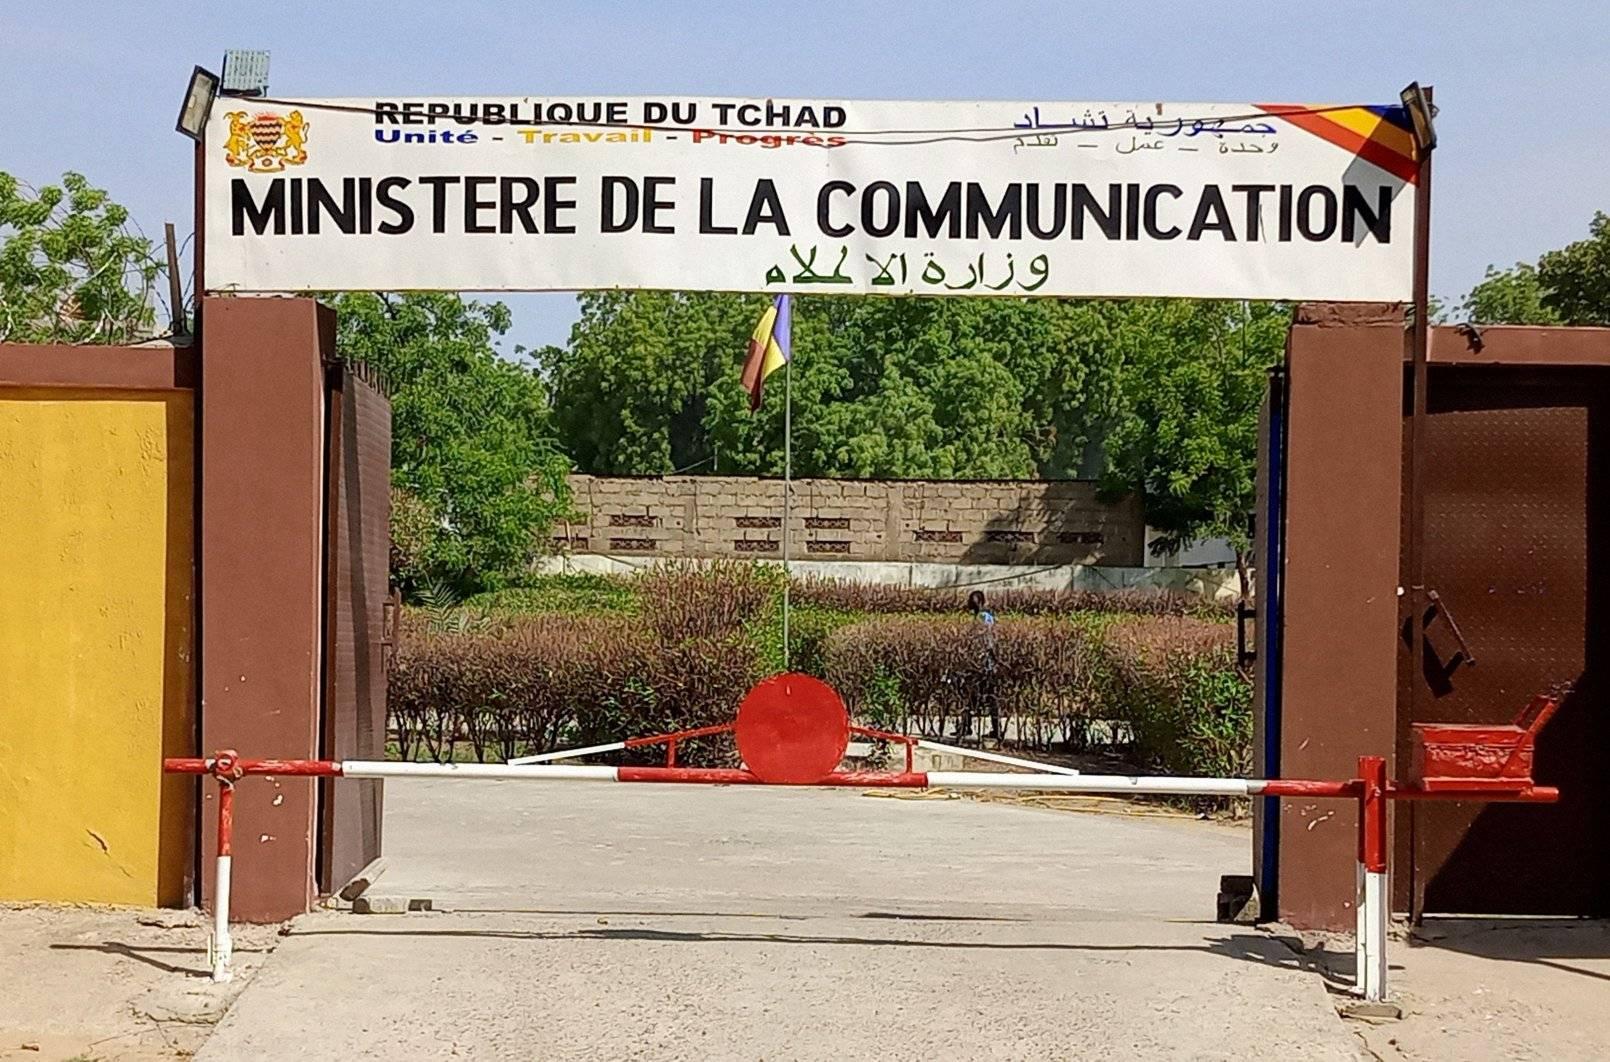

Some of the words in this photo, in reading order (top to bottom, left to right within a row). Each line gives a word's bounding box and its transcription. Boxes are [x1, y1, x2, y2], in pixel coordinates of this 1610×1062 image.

[375, 102, 628, 125] REPUBLIQUE
[643, 102, 697, 124] DU
[712, 103, 847, 128] TCHAD
[375, 129, 479, 144] Unité
[517, 128, 652, 144] Travail
[692, 128, 847, 149] Progrès
[231, 176, 577, 235] MINISTERE
[601, 175, 676, 234] DE
[700, 177, 791, 235] LA
[816, 181, 1391, 245] COMMUNICATION
[921, 252, 1049, 292] وزارة
